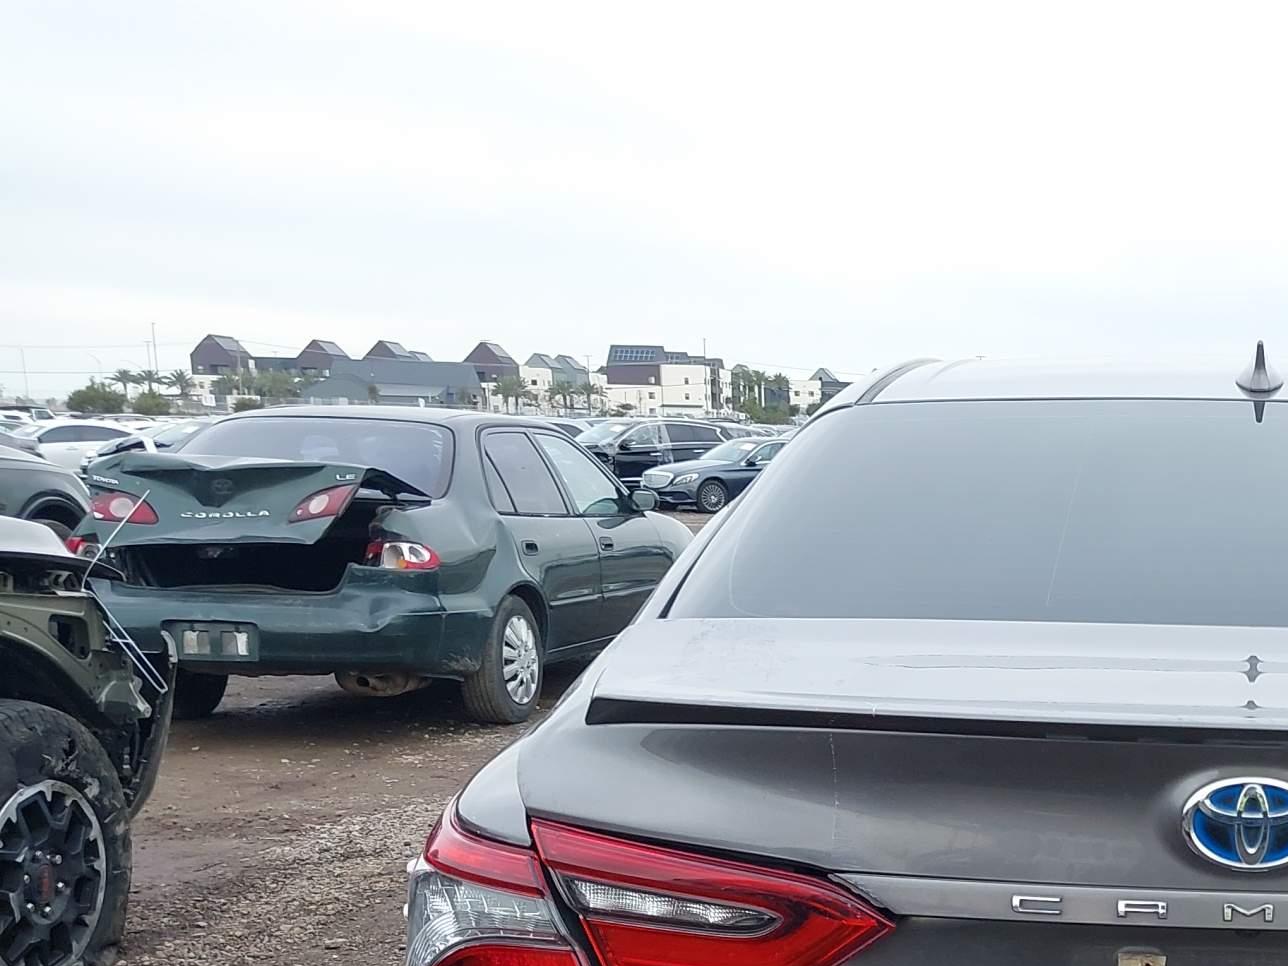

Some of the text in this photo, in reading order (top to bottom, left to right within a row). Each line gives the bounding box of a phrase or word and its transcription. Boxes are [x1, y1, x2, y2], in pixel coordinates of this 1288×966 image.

[92, 474, 120, 485] TOYOTA
[335, 473, 356, 481] LE
[180, 510, 270, 519] COROLLA
